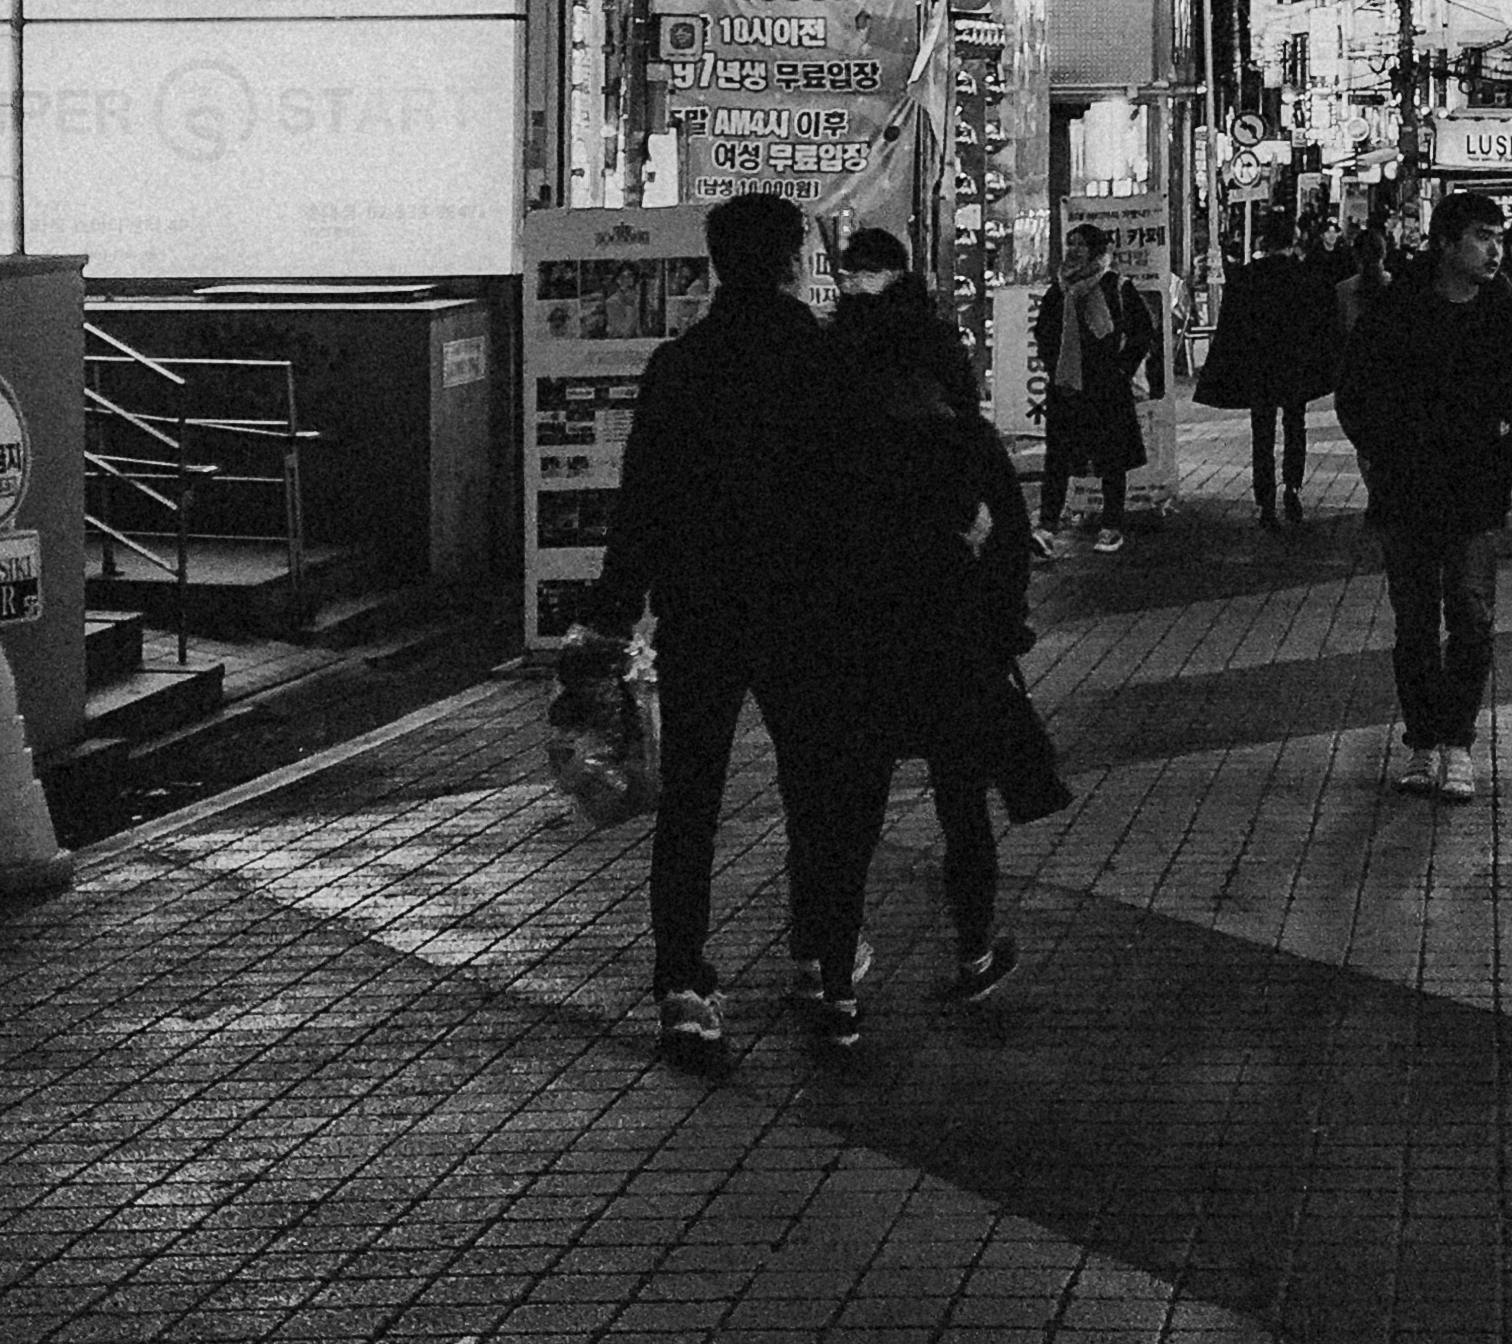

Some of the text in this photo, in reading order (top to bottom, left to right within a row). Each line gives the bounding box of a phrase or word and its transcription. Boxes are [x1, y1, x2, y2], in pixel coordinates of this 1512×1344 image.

[717, 15, 829, 48] 10시이전
[774, 60, 882, 92] 무료입장
[712, 108, 792, 139] AM4시
[793, 109, 849, 138] 이후
[713, 140, 872, 174] 여성 무료입장
